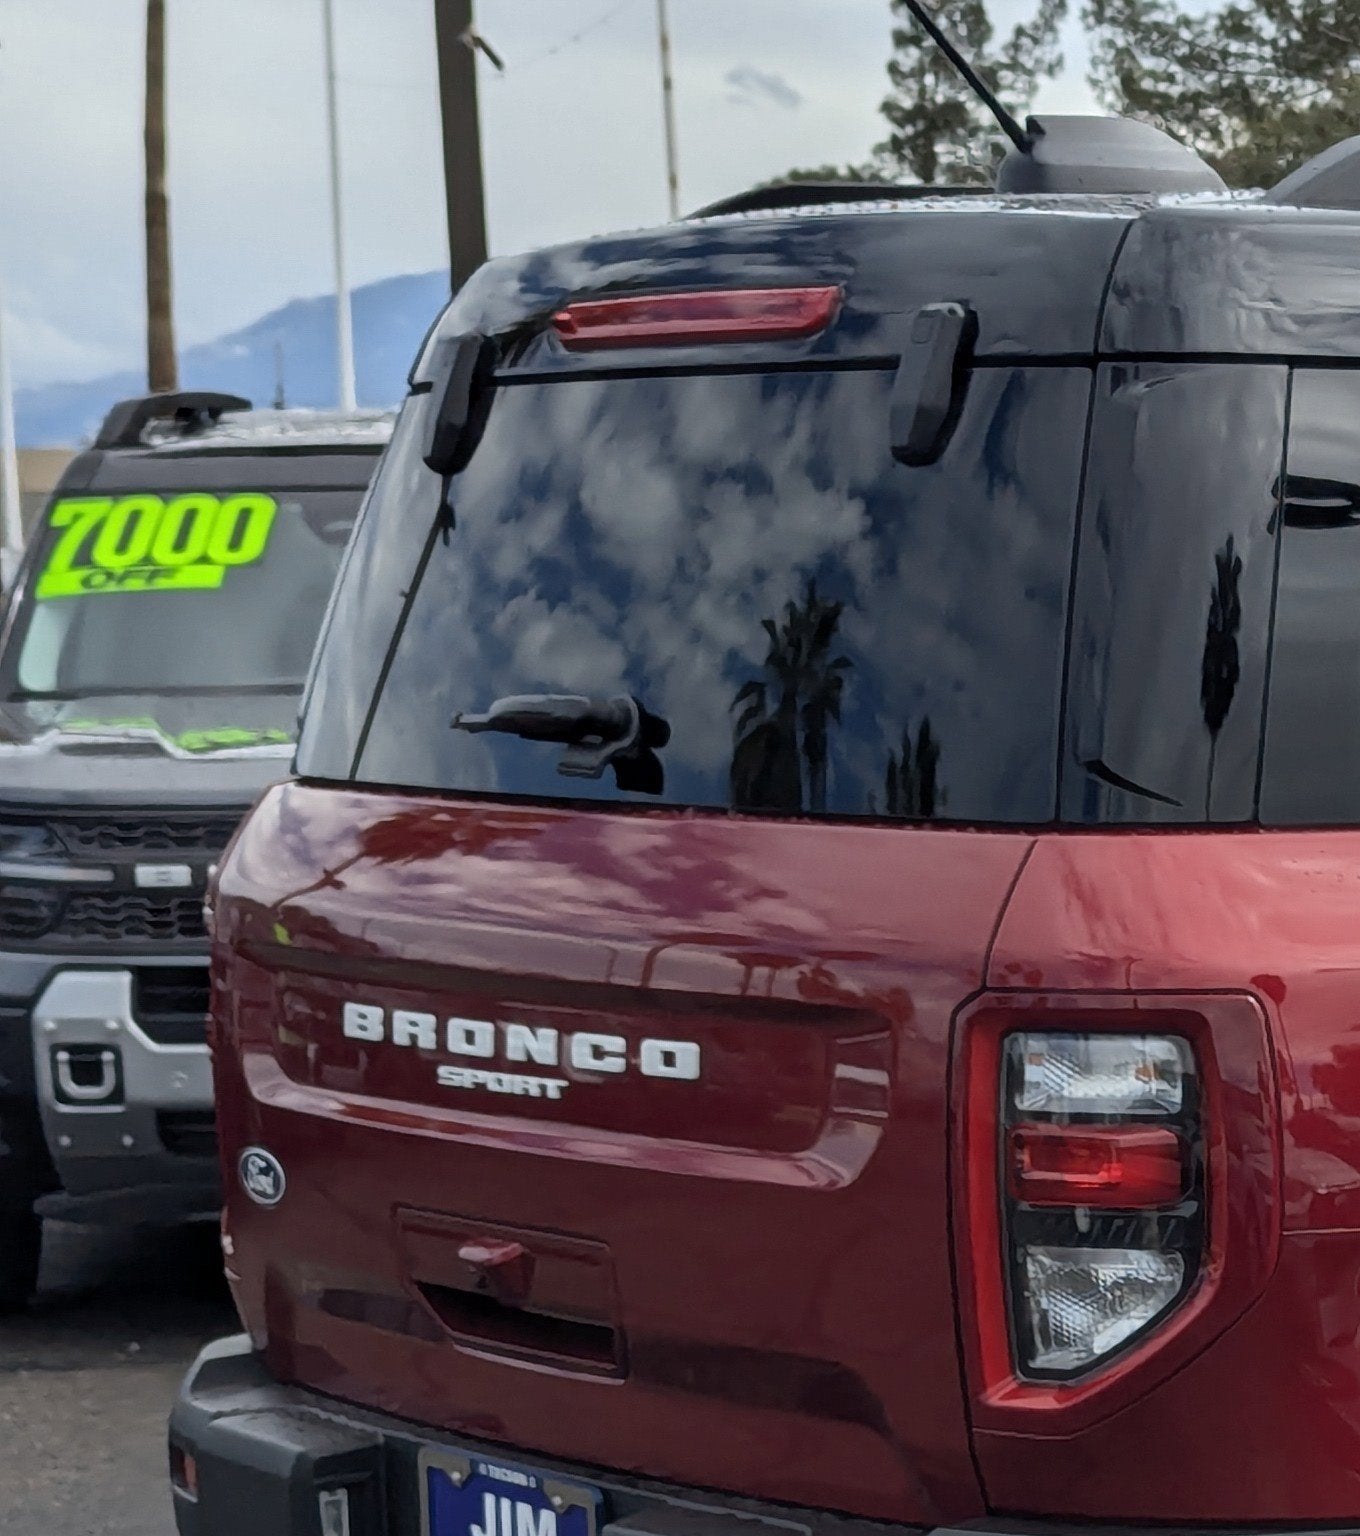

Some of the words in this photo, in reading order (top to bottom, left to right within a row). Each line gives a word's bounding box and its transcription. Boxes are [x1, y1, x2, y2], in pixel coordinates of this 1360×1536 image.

[50, 493, 278, 573] 7000
[80, 566, 178, 590] OFF
[342, 1001, 700, 1080] BRONCO
[436, 1065, 570, 1099] SPORT
